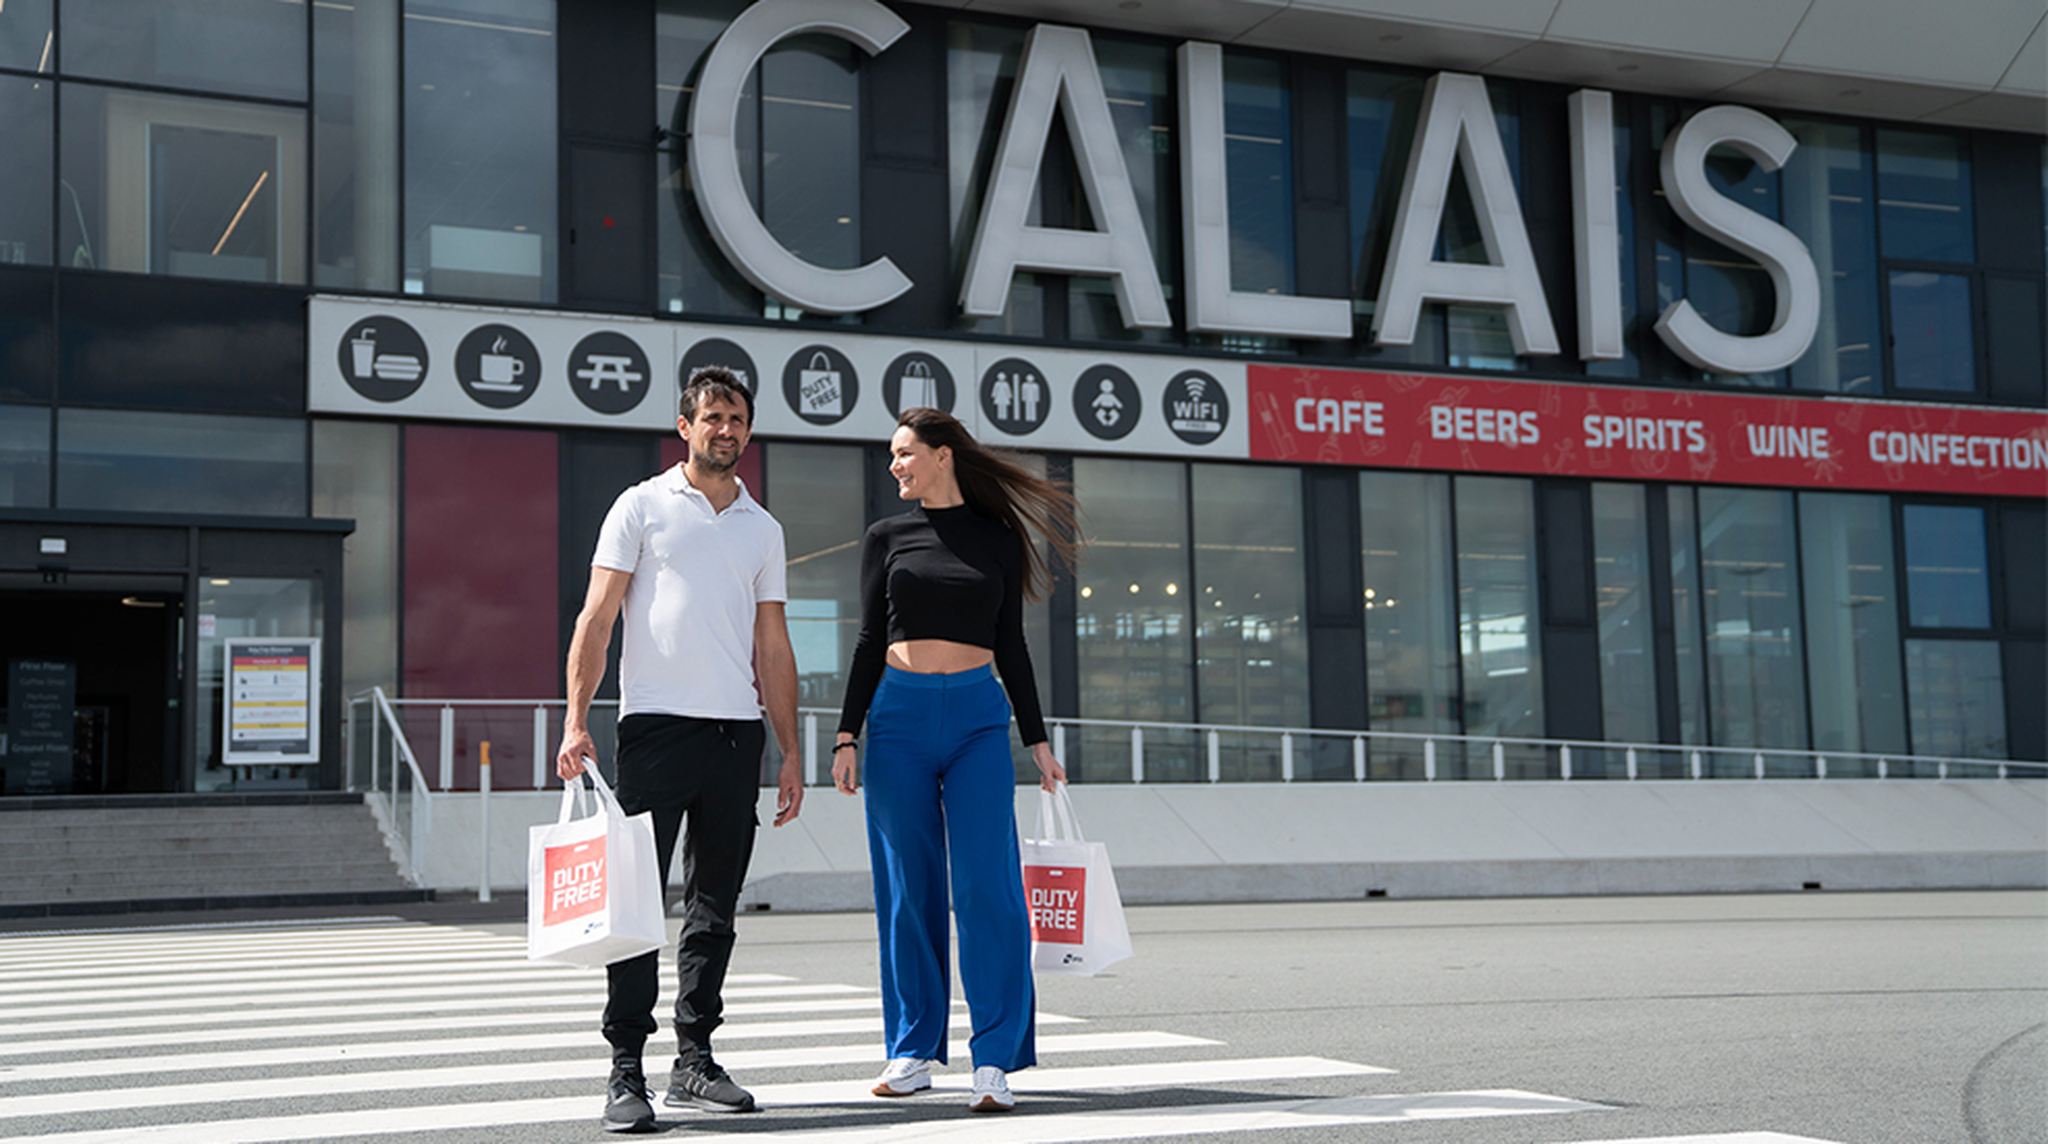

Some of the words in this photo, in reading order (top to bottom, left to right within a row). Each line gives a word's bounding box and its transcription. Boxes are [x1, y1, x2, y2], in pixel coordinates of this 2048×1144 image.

[689, 0, 1821, 374] CALAIS
[801, 373, 832, 399] DUTY
[809, 386, 840, 410] FREE
[1294, 398, 1385, 436] CAFE
[1431, 405, 1540, 444] BEERS
[1583, 414, 1706, 453] SPIRITS
[1747, 424, 1829, 459] WINE
[1869, 430, 2048, 470] CONFECTION
[554, 859, 603, 889] DUTY
[553, 879, 602, 911] FREE
[1032, 889, 1078, 907] DUTY
[1031, 909, 1077, 929] FREE
